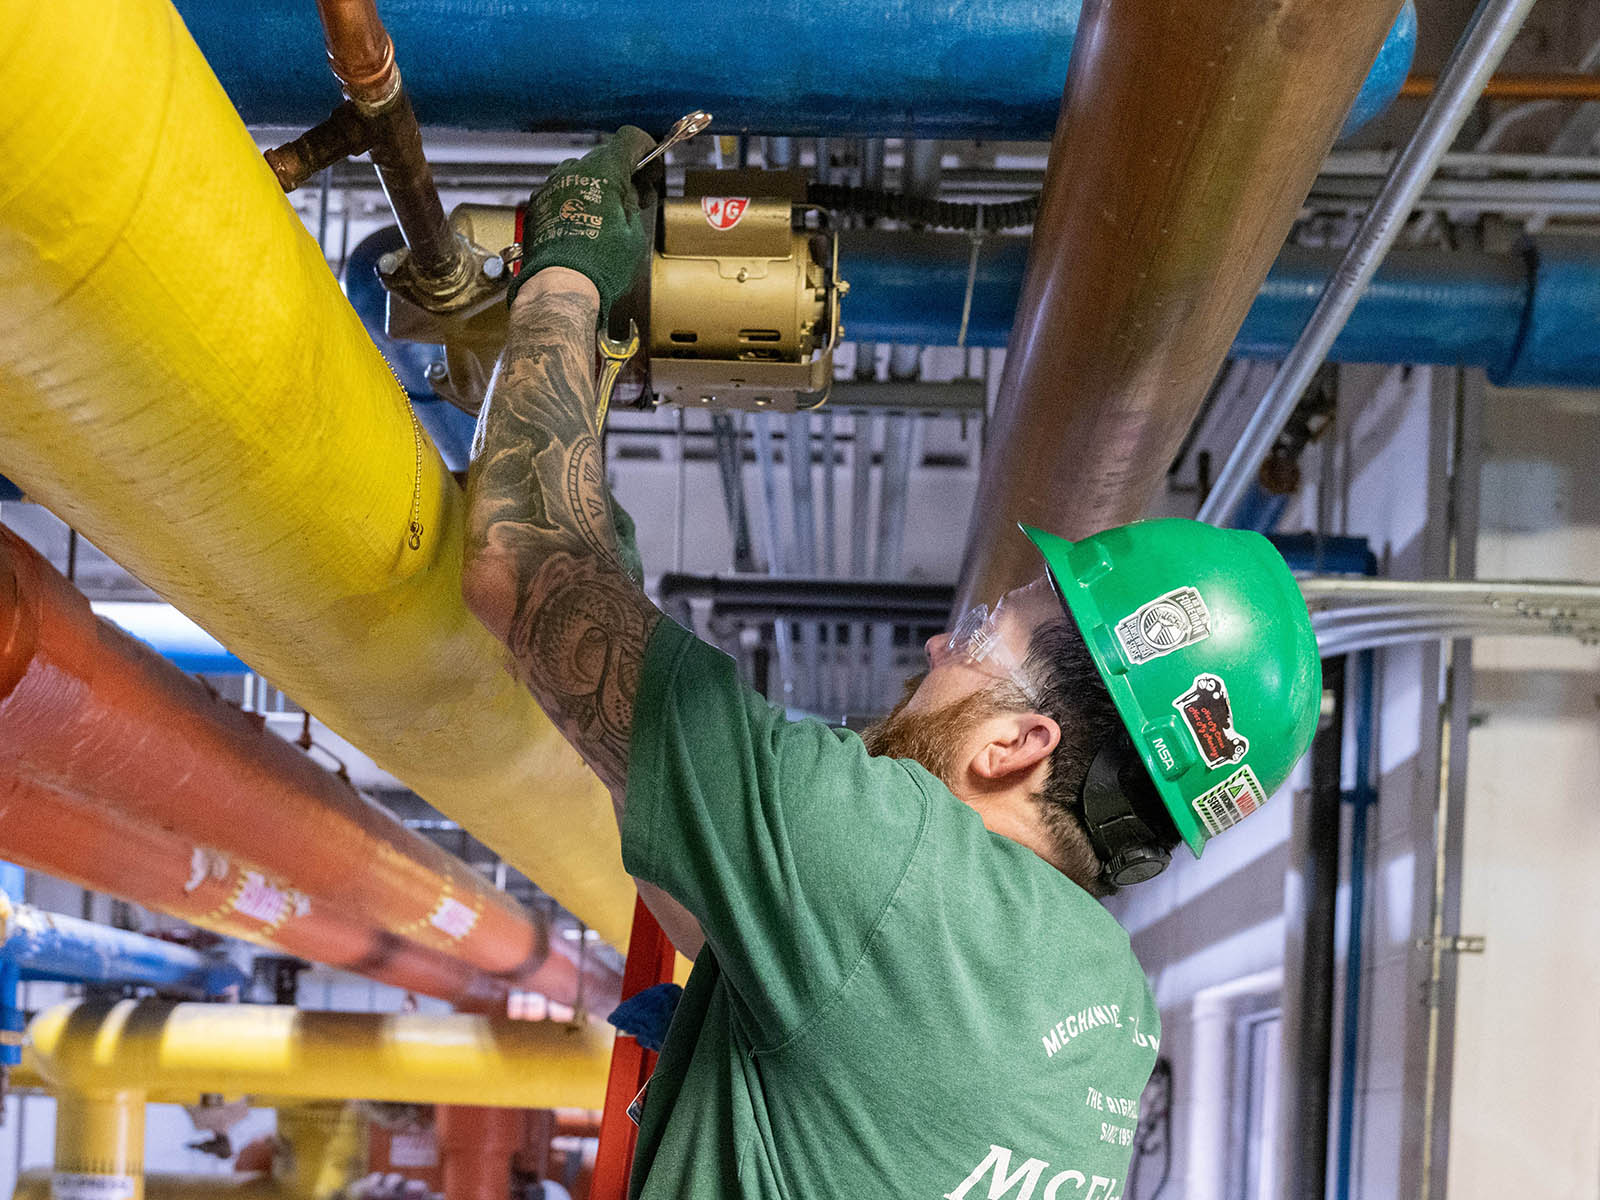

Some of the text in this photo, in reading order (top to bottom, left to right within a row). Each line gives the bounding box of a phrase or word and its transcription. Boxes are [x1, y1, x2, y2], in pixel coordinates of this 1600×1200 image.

[1176, 594, 1205, 634] FOREMAN
[1152, 738, 1174, 771] MSA
[1207, 796, 1226, 819] SEVERE
[1085, 1086, 1104, 1111] THE
